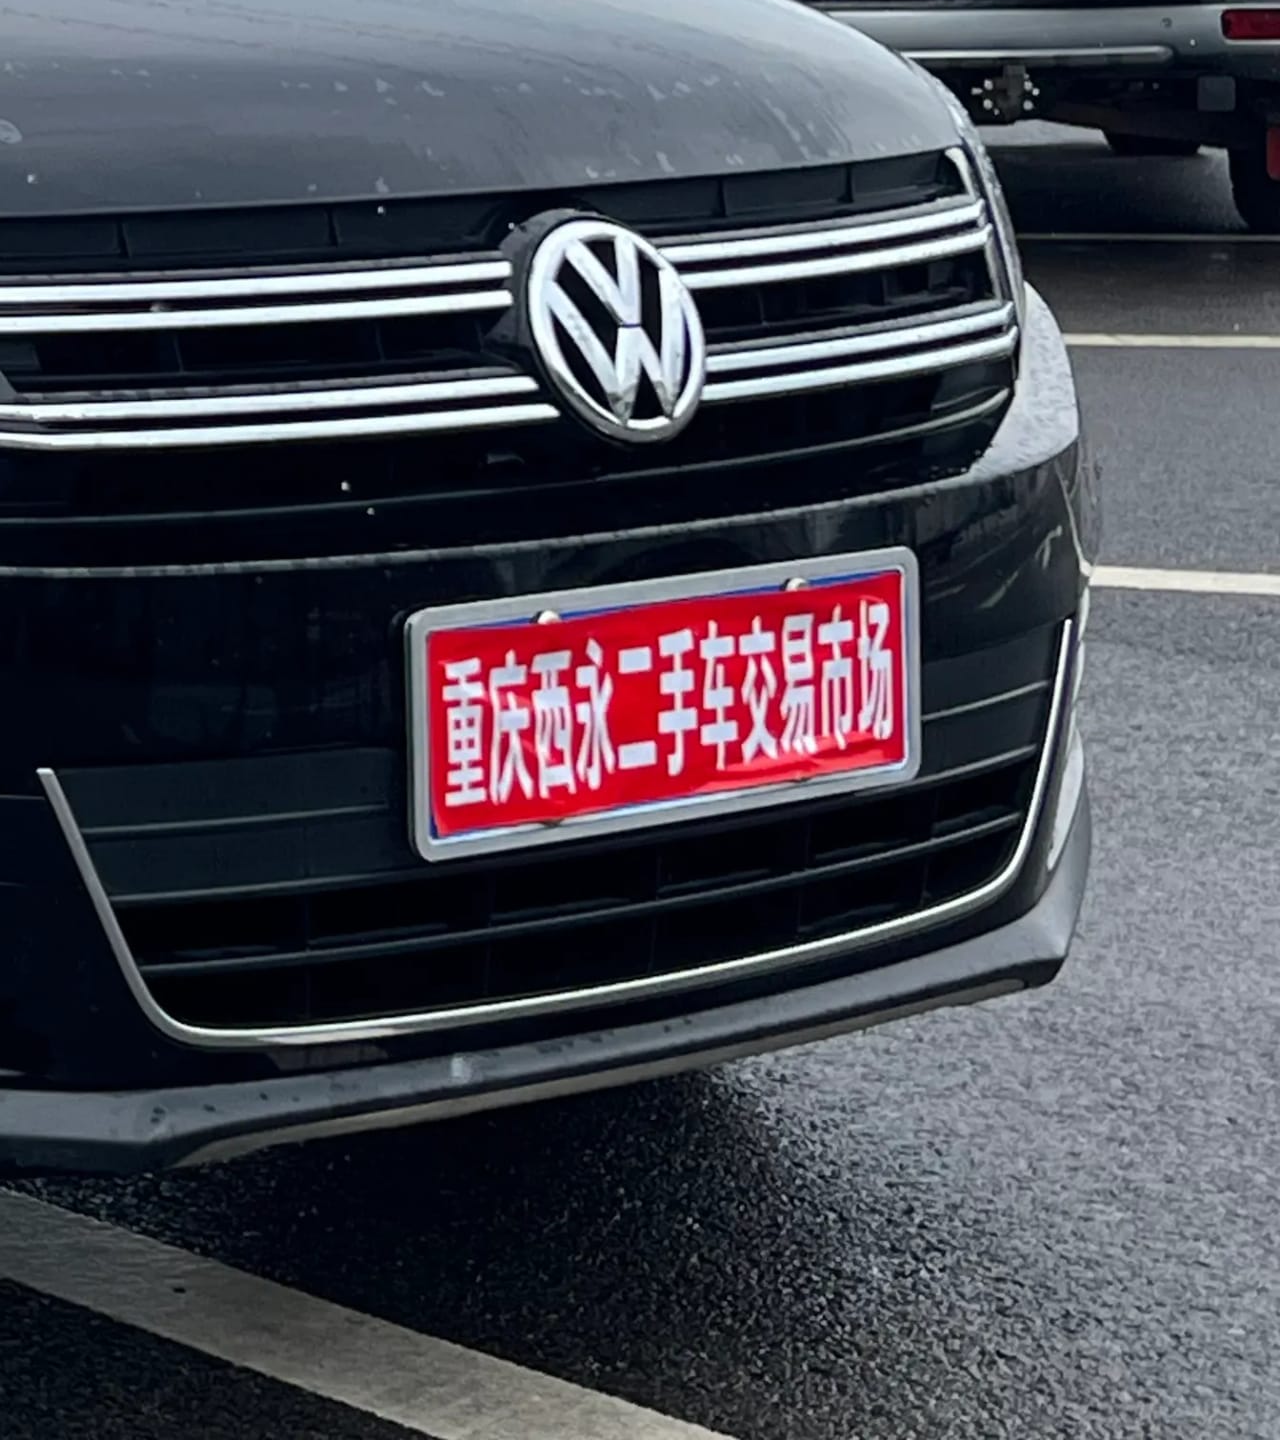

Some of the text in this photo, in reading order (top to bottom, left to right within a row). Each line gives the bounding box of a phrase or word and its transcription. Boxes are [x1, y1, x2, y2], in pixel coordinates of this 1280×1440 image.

[442, 599, 893, 808] 重庆西永二手车交易市场
